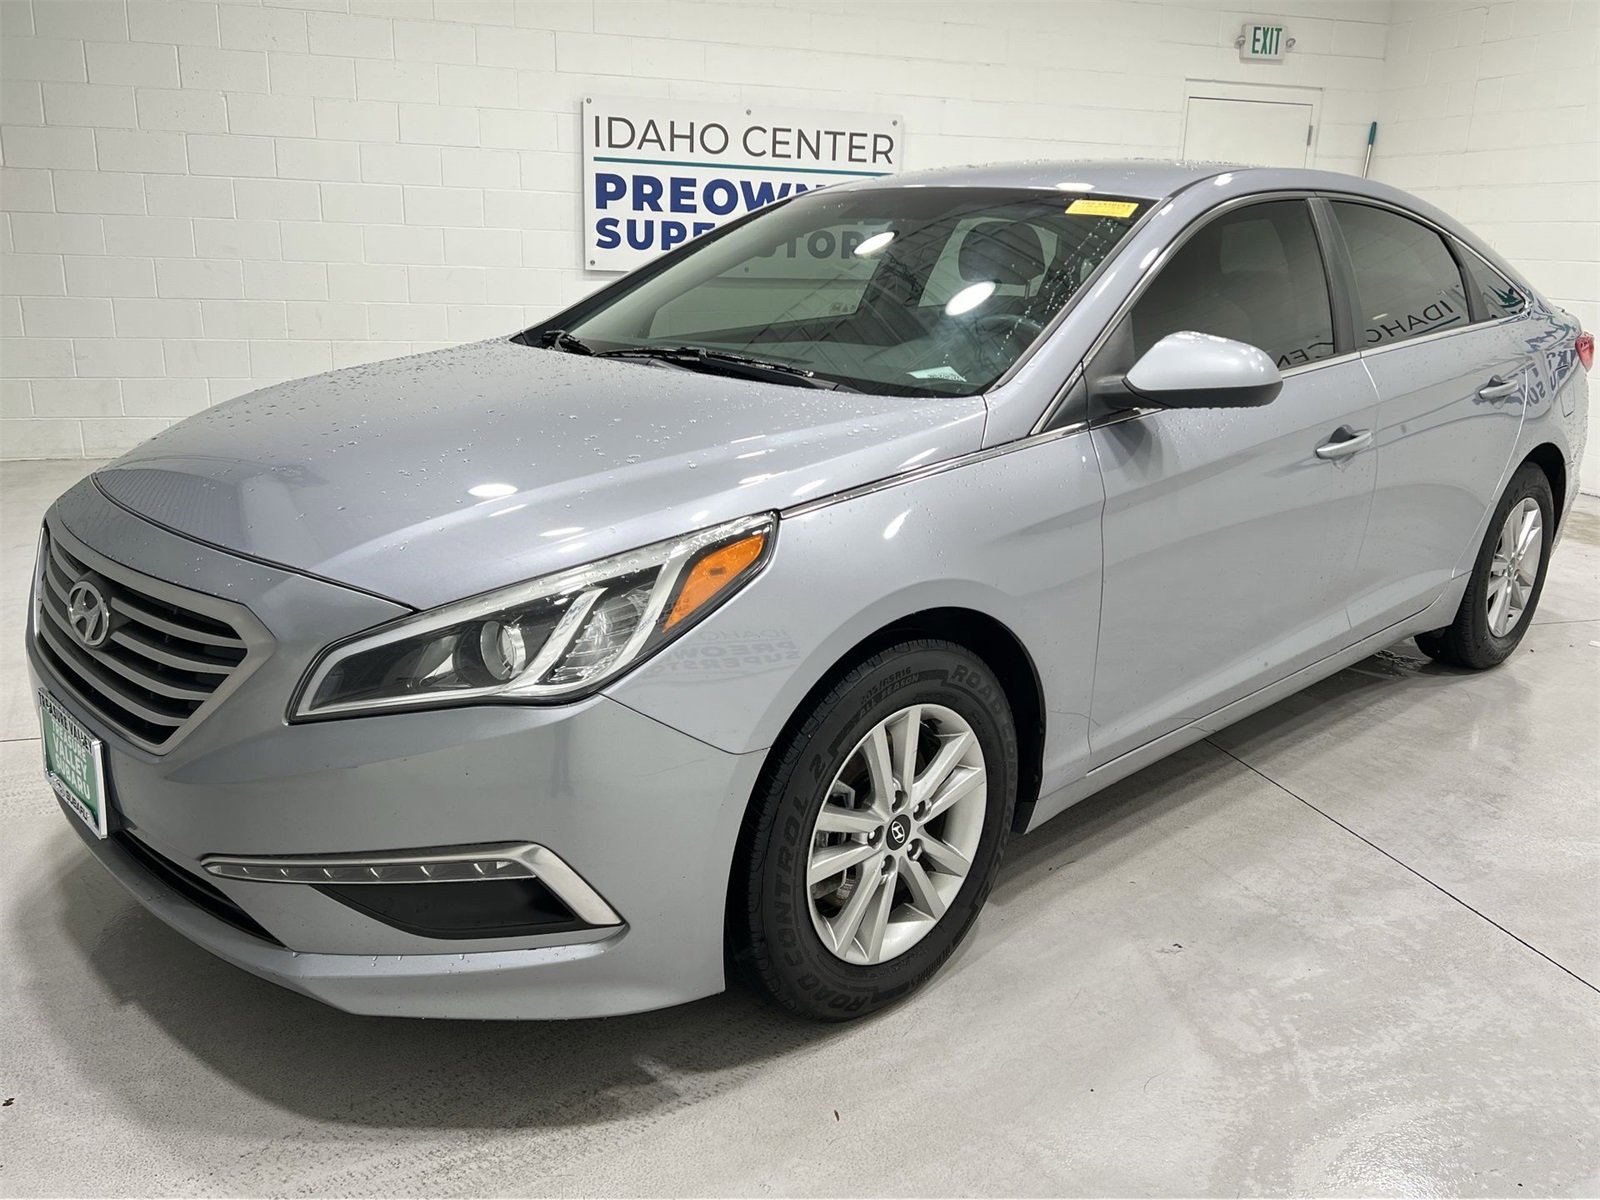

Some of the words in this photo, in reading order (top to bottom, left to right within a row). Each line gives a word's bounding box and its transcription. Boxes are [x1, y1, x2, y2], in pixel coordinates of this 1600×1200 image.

[1252, 26, 1282, 55] EXIT
[594, 115, 729, 154] IDAHO
[742, 126, 894, 164] CENTER
[595, 173, 826, 216] PREOW
[949, 664, 1003, 714] ROAD
[52, 719, 86, 763] TREASURE
[52, 733, 88, 781] VALLEY
[55, 752, 91, 800] SUBARU
[775, 795, 808, 967] CONTROL
[809, 753, 826, 782] 2
